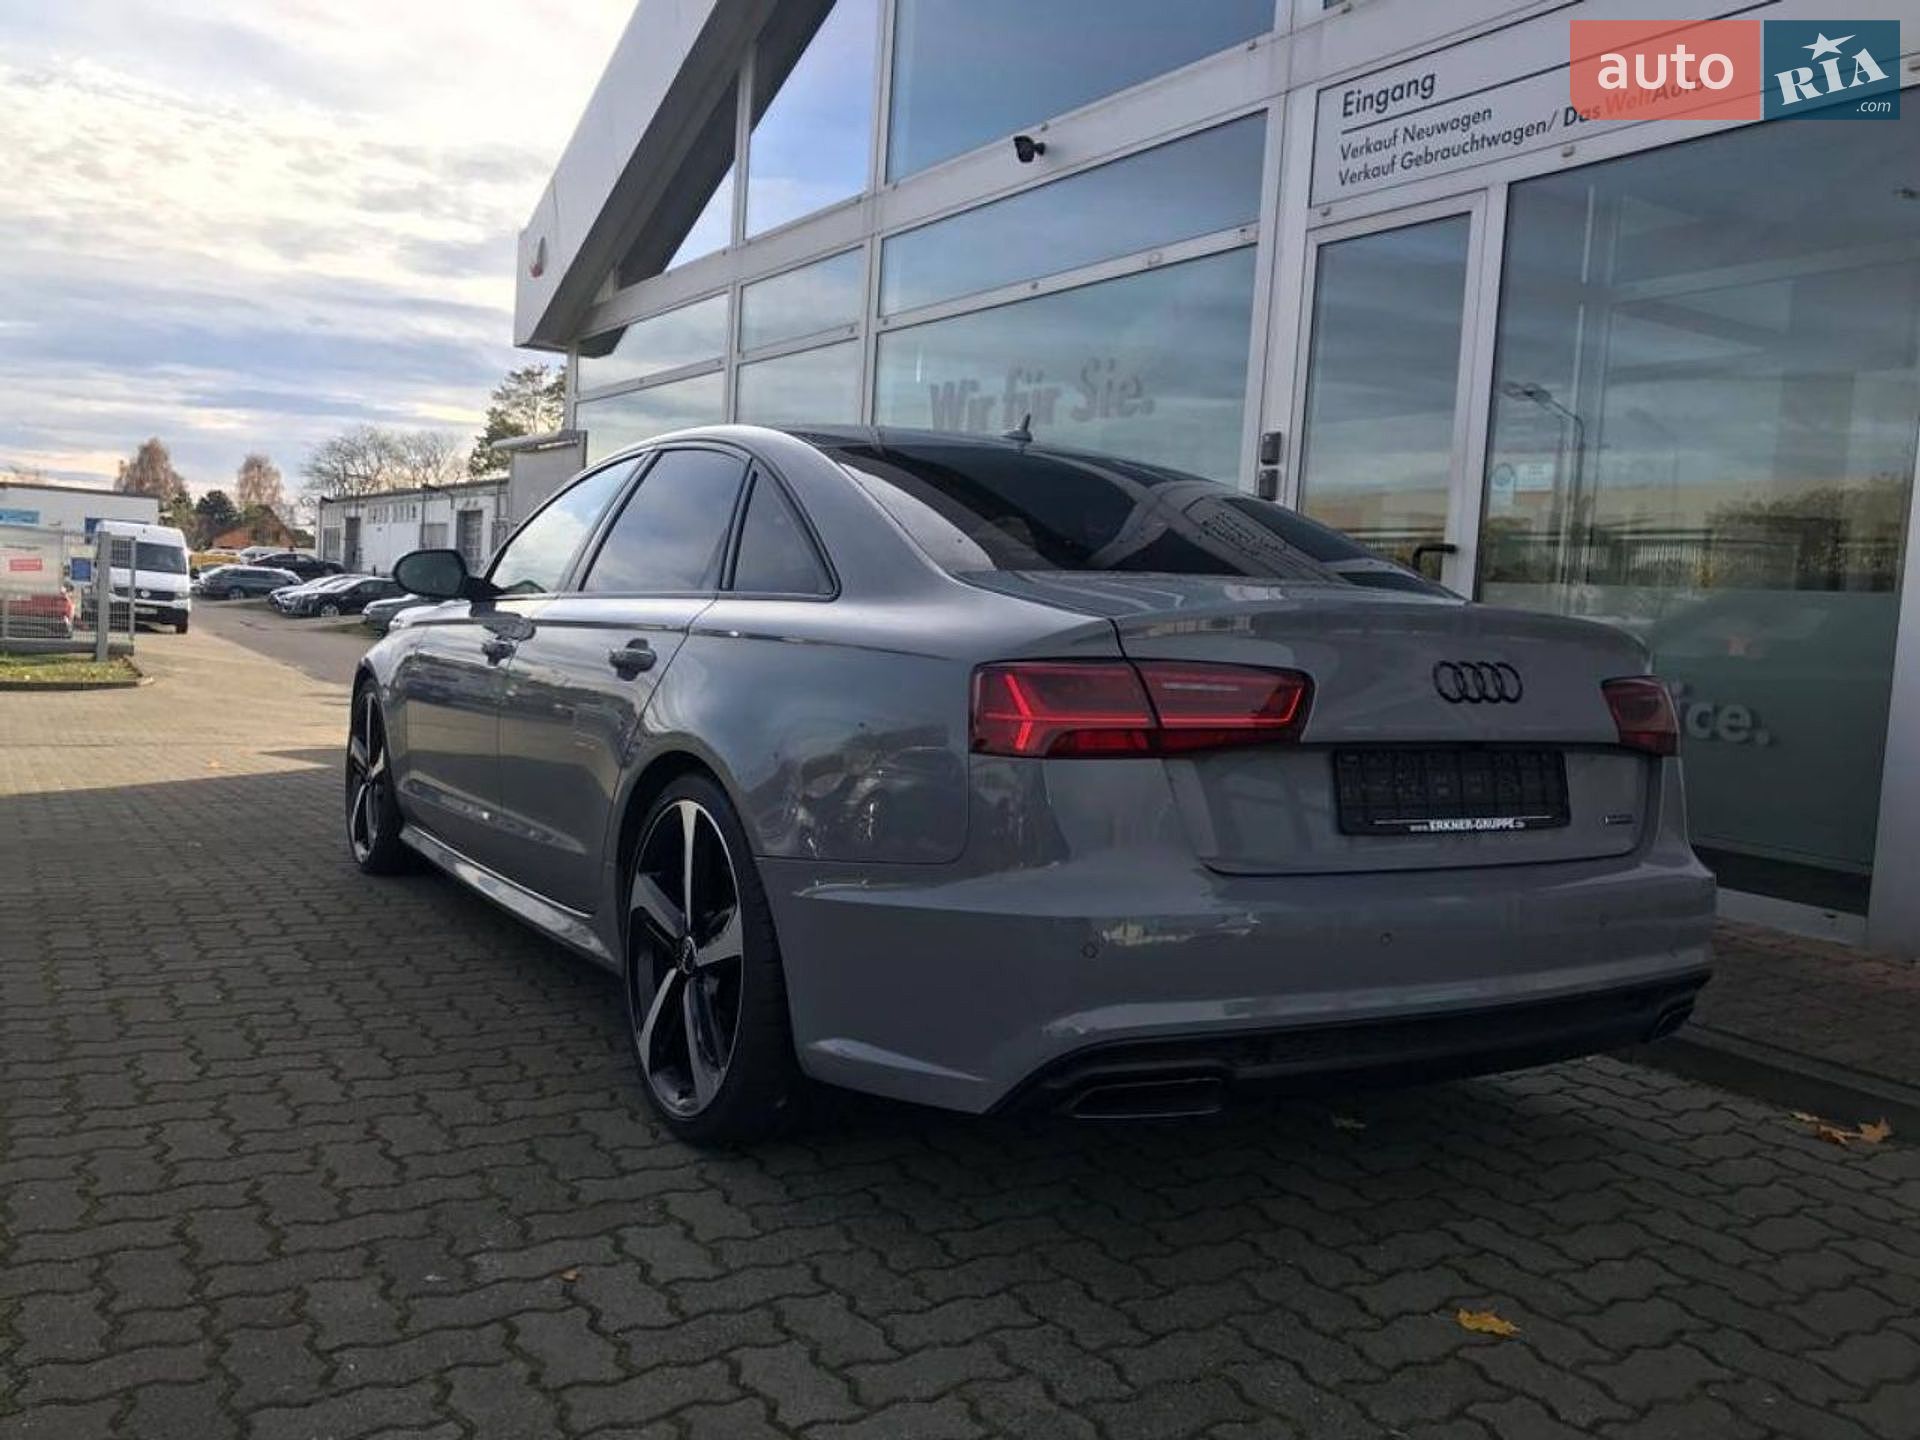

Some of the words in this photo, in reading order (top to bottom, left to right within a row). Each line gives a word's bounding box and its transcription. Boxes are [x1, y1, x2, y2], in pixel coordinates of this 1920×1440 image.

[1342, 72, 1436, 118] Eingang
[1338, 153, 1395, 186] Verkauf
[1563, 104, 1601, 127] Das
[1340, 129, 1397, 161] Verkauf
[1402, 108, 1493, 144] Neuwagen
[1004, 365, 1061, 425] für
